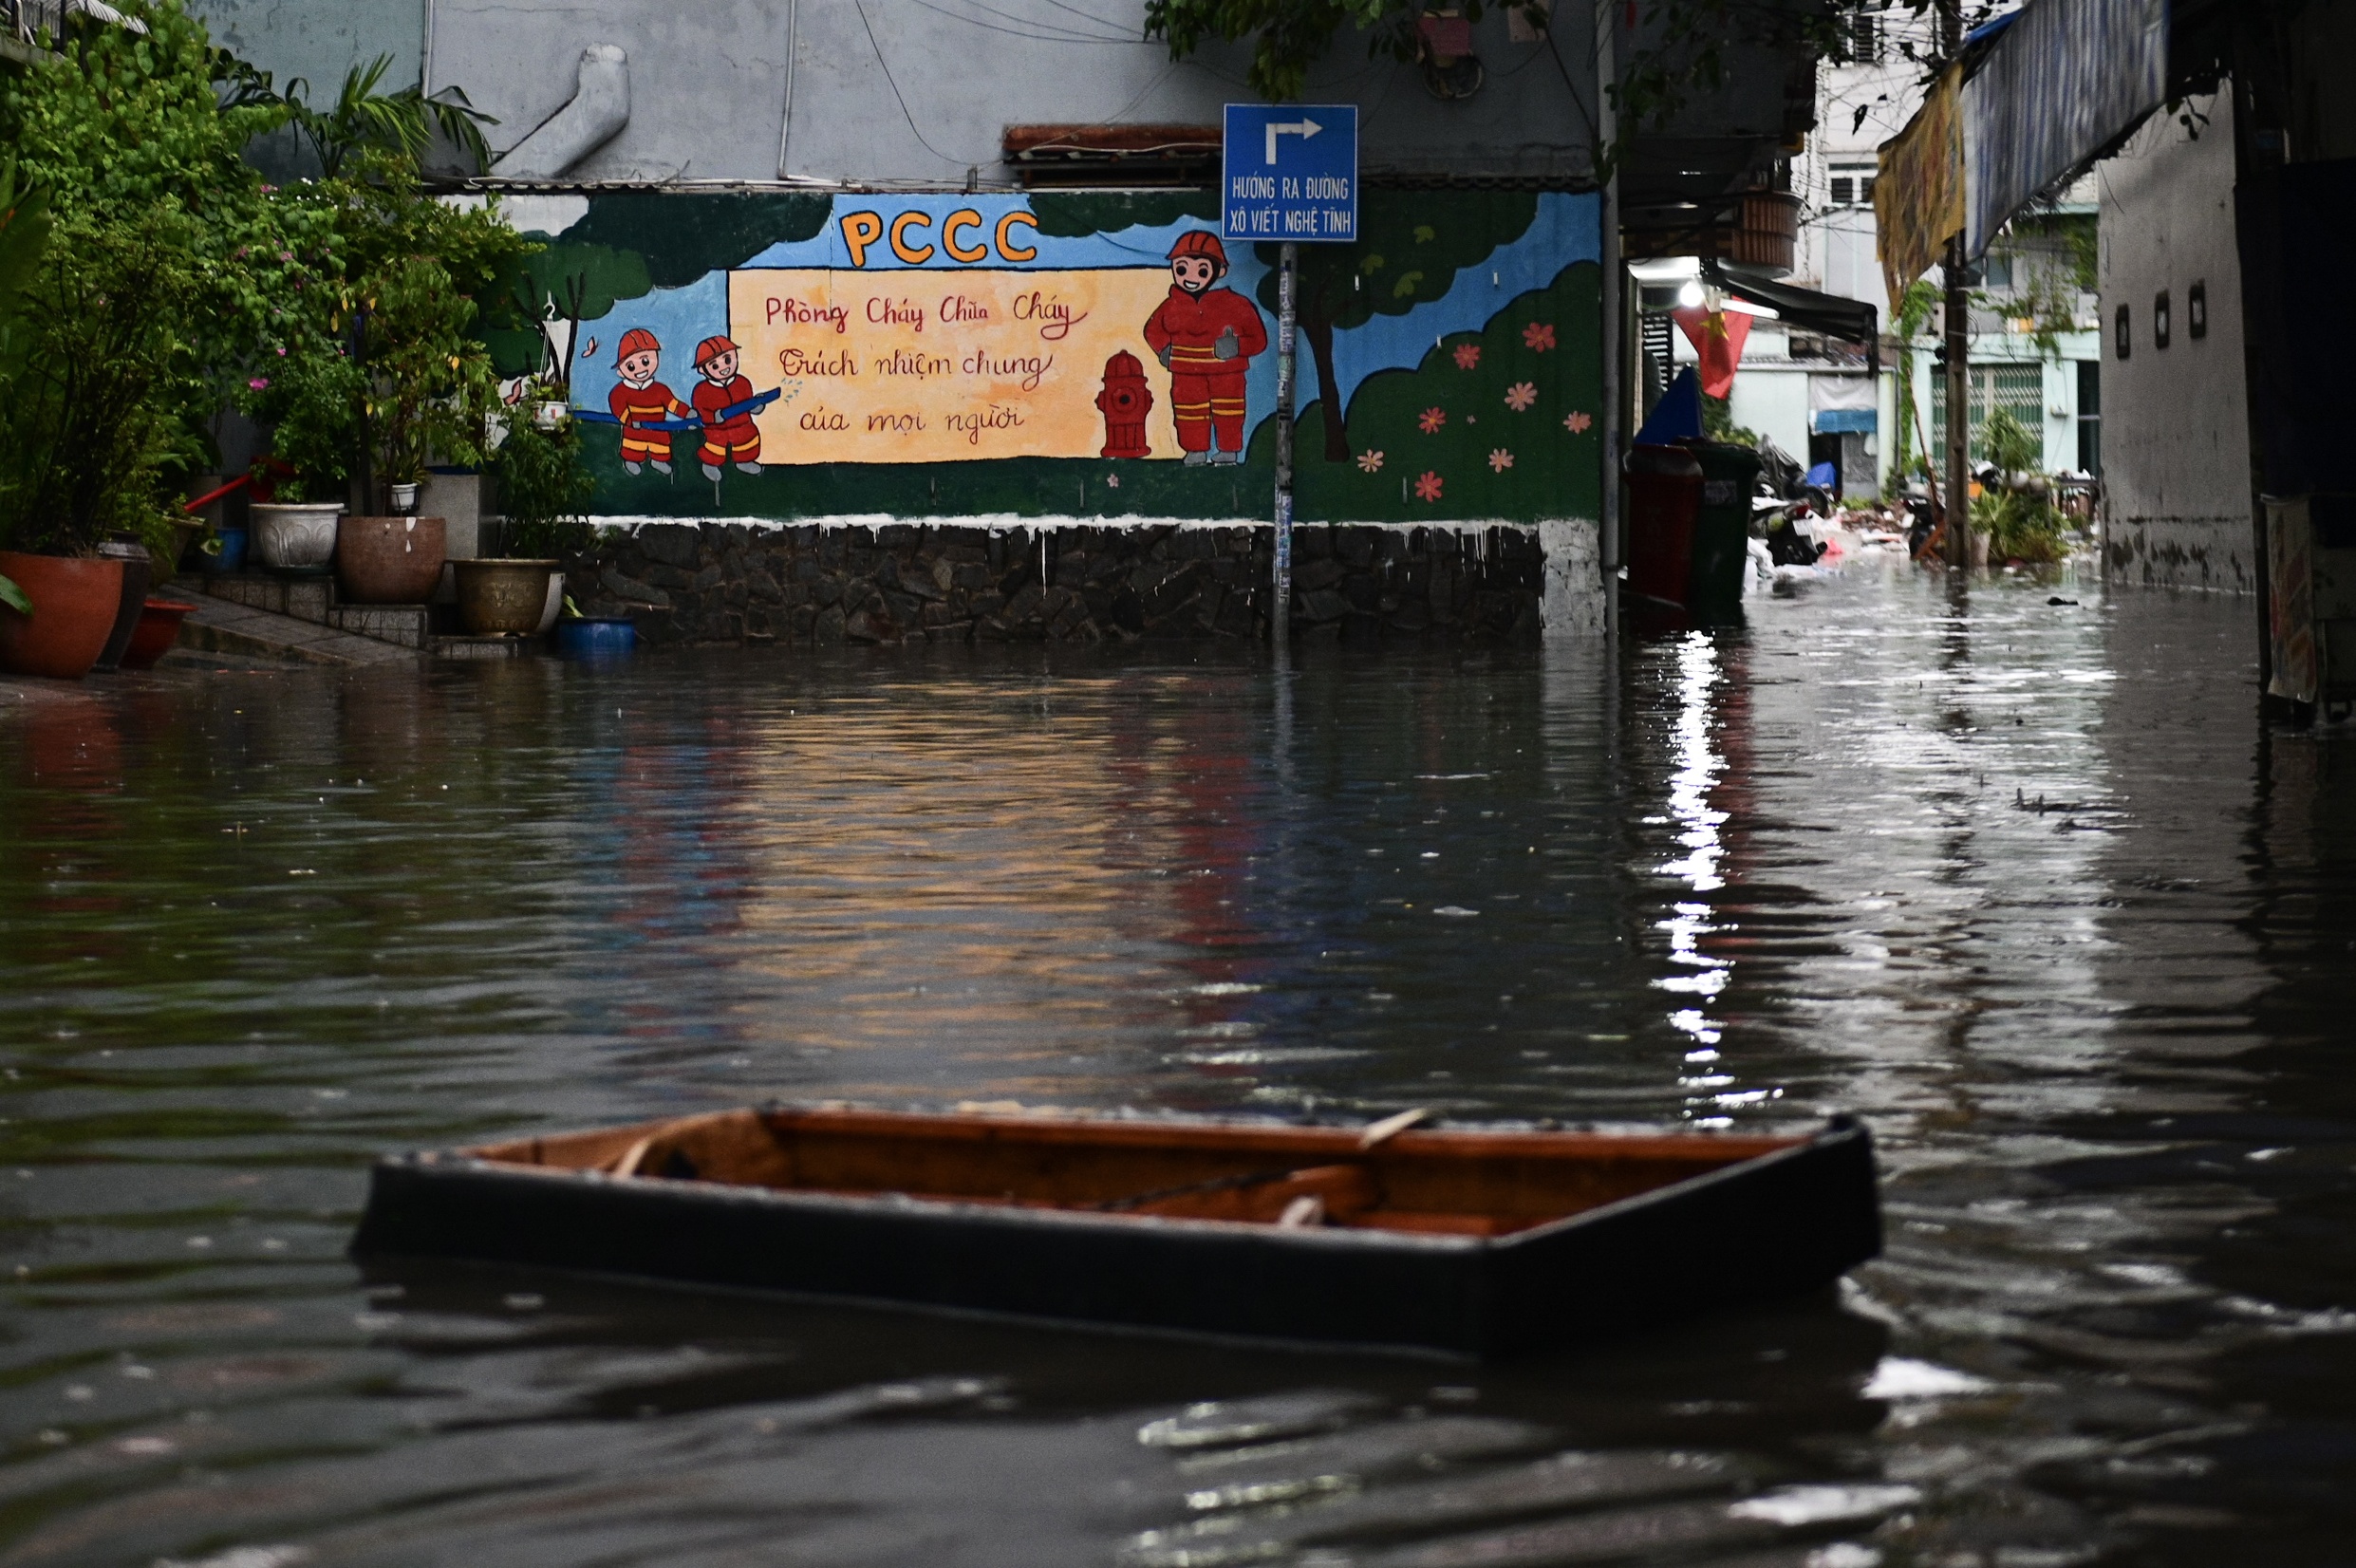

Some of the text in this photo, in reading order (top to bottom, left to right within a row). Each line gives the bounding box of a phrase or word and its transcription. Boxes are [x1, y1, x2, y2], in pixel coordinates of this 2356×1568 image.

[1282, 177, 1300, 199] RA
[840, 209, 1038, 268] PCCC
[1230, 203, 1351, 235] XÔ VIẾT NGHỆ TĨNH
[765, 297, 850, 334] Phòng
[866, 297, 925, 332] Cháy
[778, 348, 1054, 392] Trách nhiệm chung
[799, 403, 1025, 445] của mọi người
